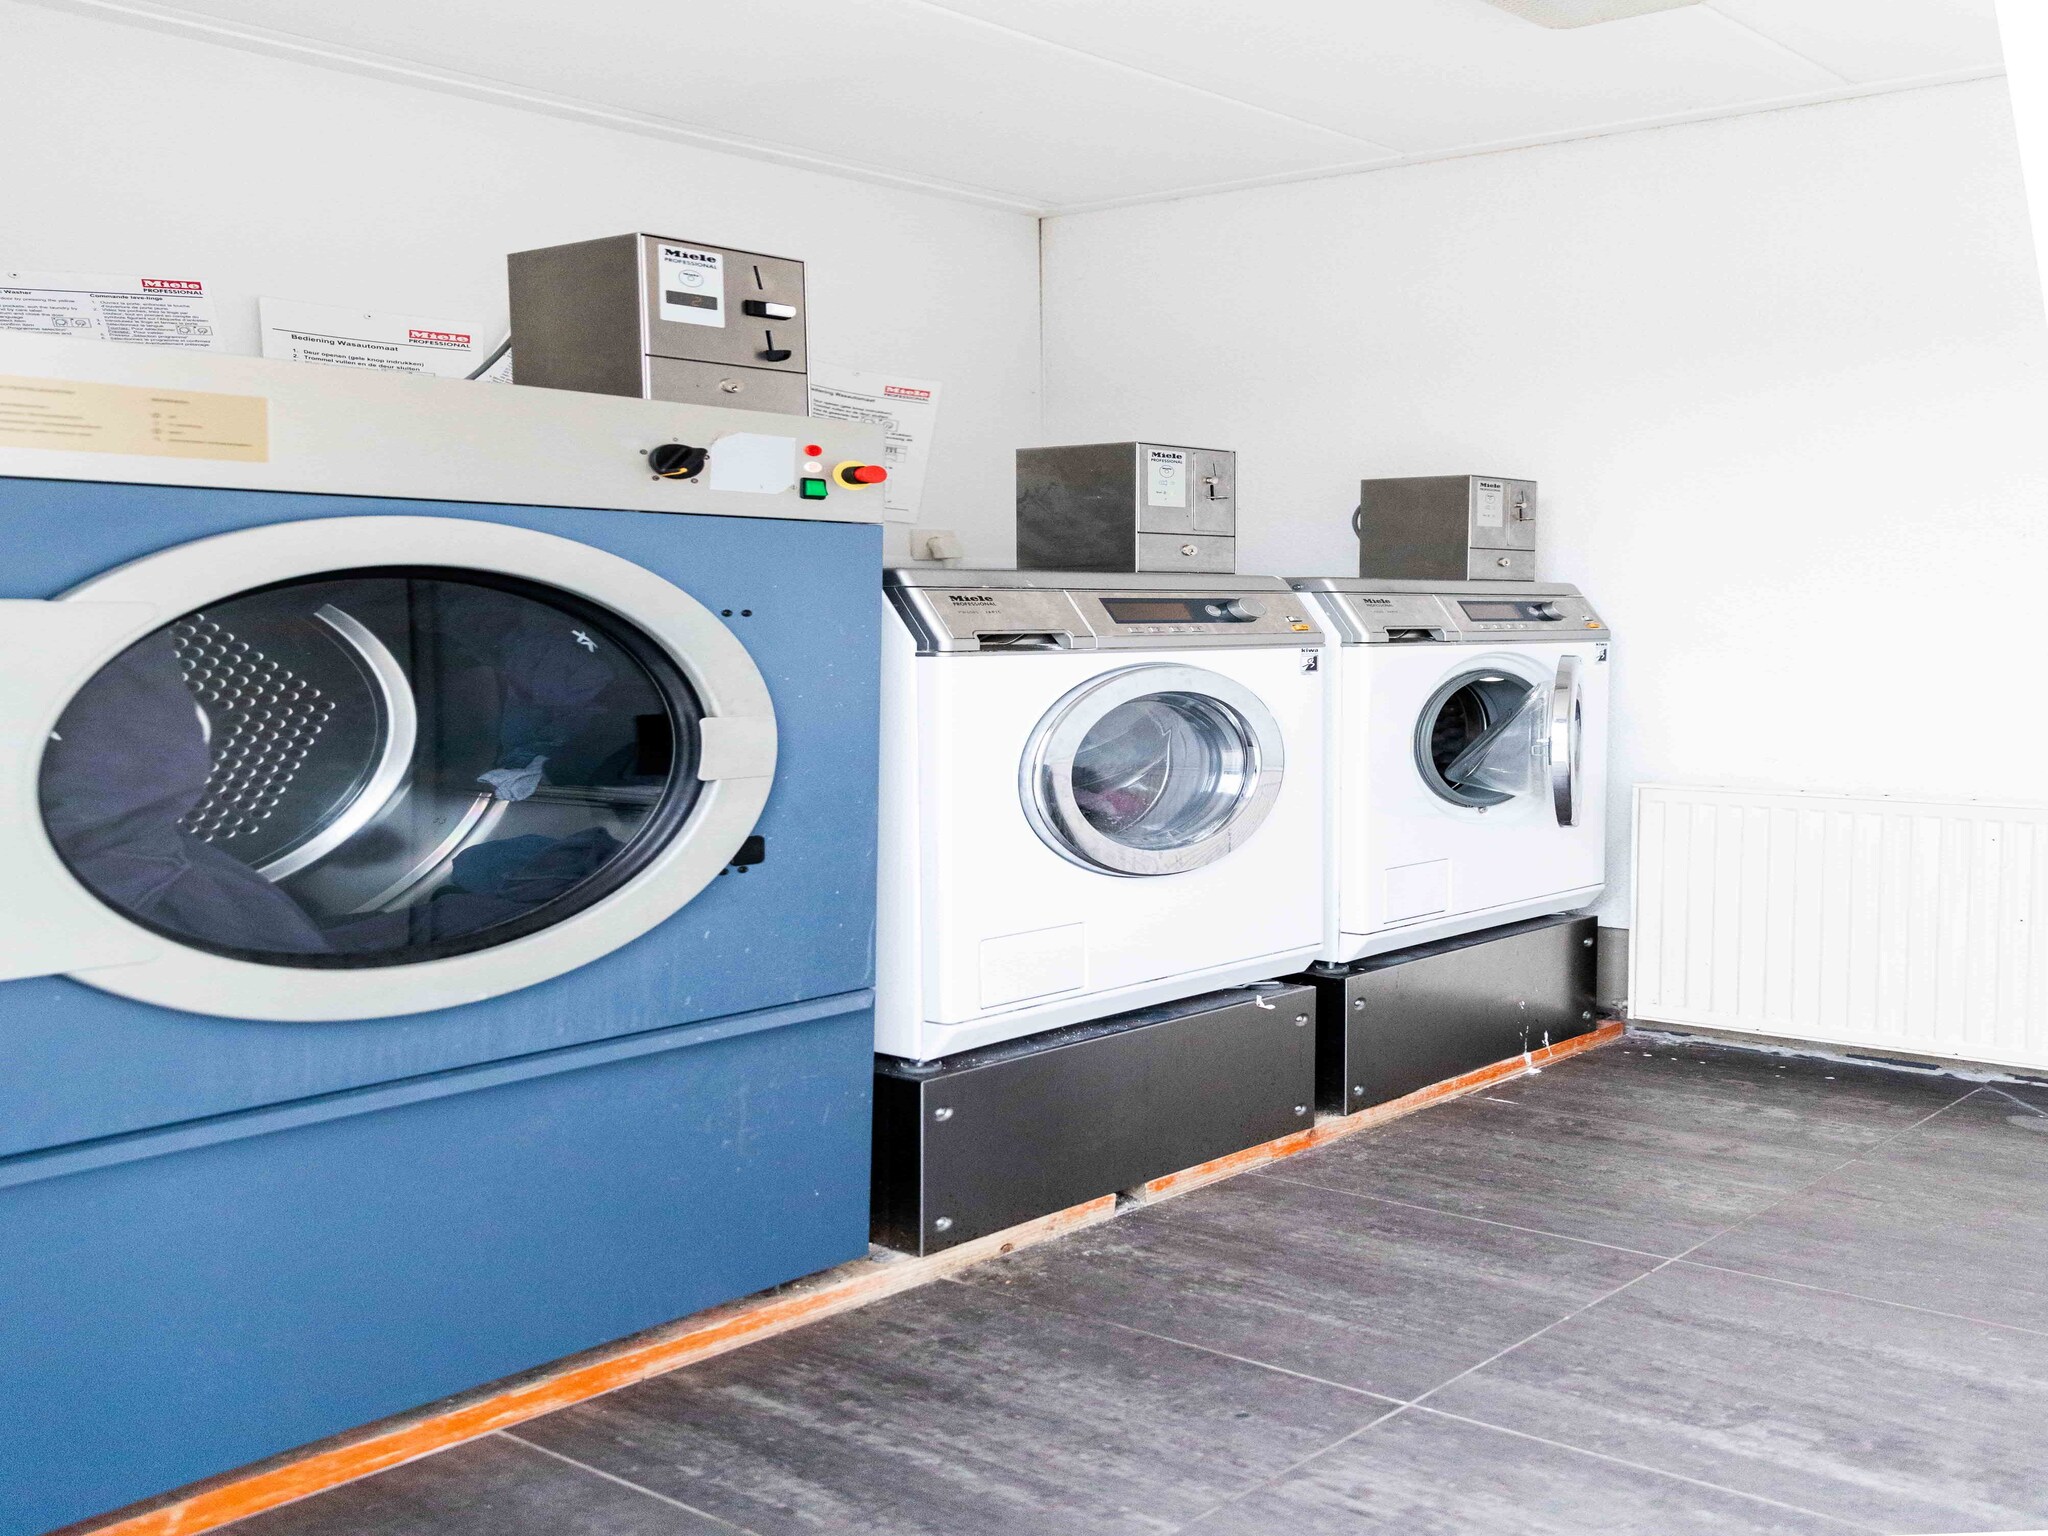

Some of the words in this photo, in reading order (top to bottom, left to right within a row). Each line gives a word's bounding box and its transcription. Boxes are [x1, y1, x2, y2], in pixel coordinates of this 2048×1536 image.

[665, 248, 716, 263] Miele
[664, 257, 717, 269] PROFESSIONAL
[144, 280, 200, 289] Miele
[411, 331, 469, 342] Miele
[291, 334, 335, 345] Bediening
[337, 340, 398, 351] Wasautomaat
[409, 339, 470, 348] PROFESSIONAL
[886, 386, 929, 397] Miele
[1151, 451, 1182, 459] Miele
